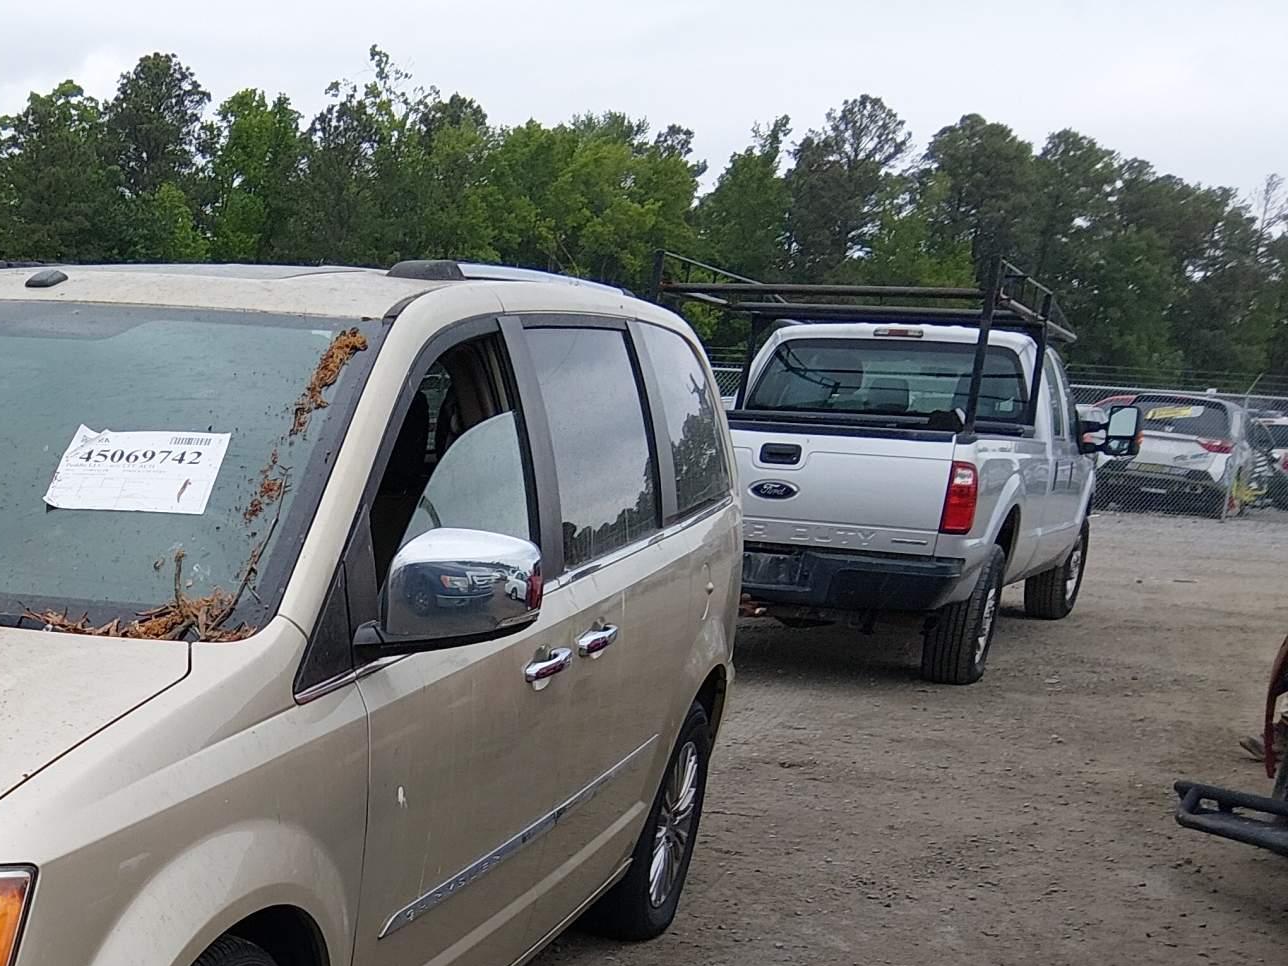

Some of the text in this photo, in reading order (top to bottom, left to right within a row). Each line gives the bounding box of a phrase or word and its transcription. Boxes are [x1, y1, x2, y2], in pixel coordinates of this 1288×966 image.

[79, 449, 202, 465] 45069742
[760, 482, 785, 497] Ford
[789, 527, 876, 546] DUTY
